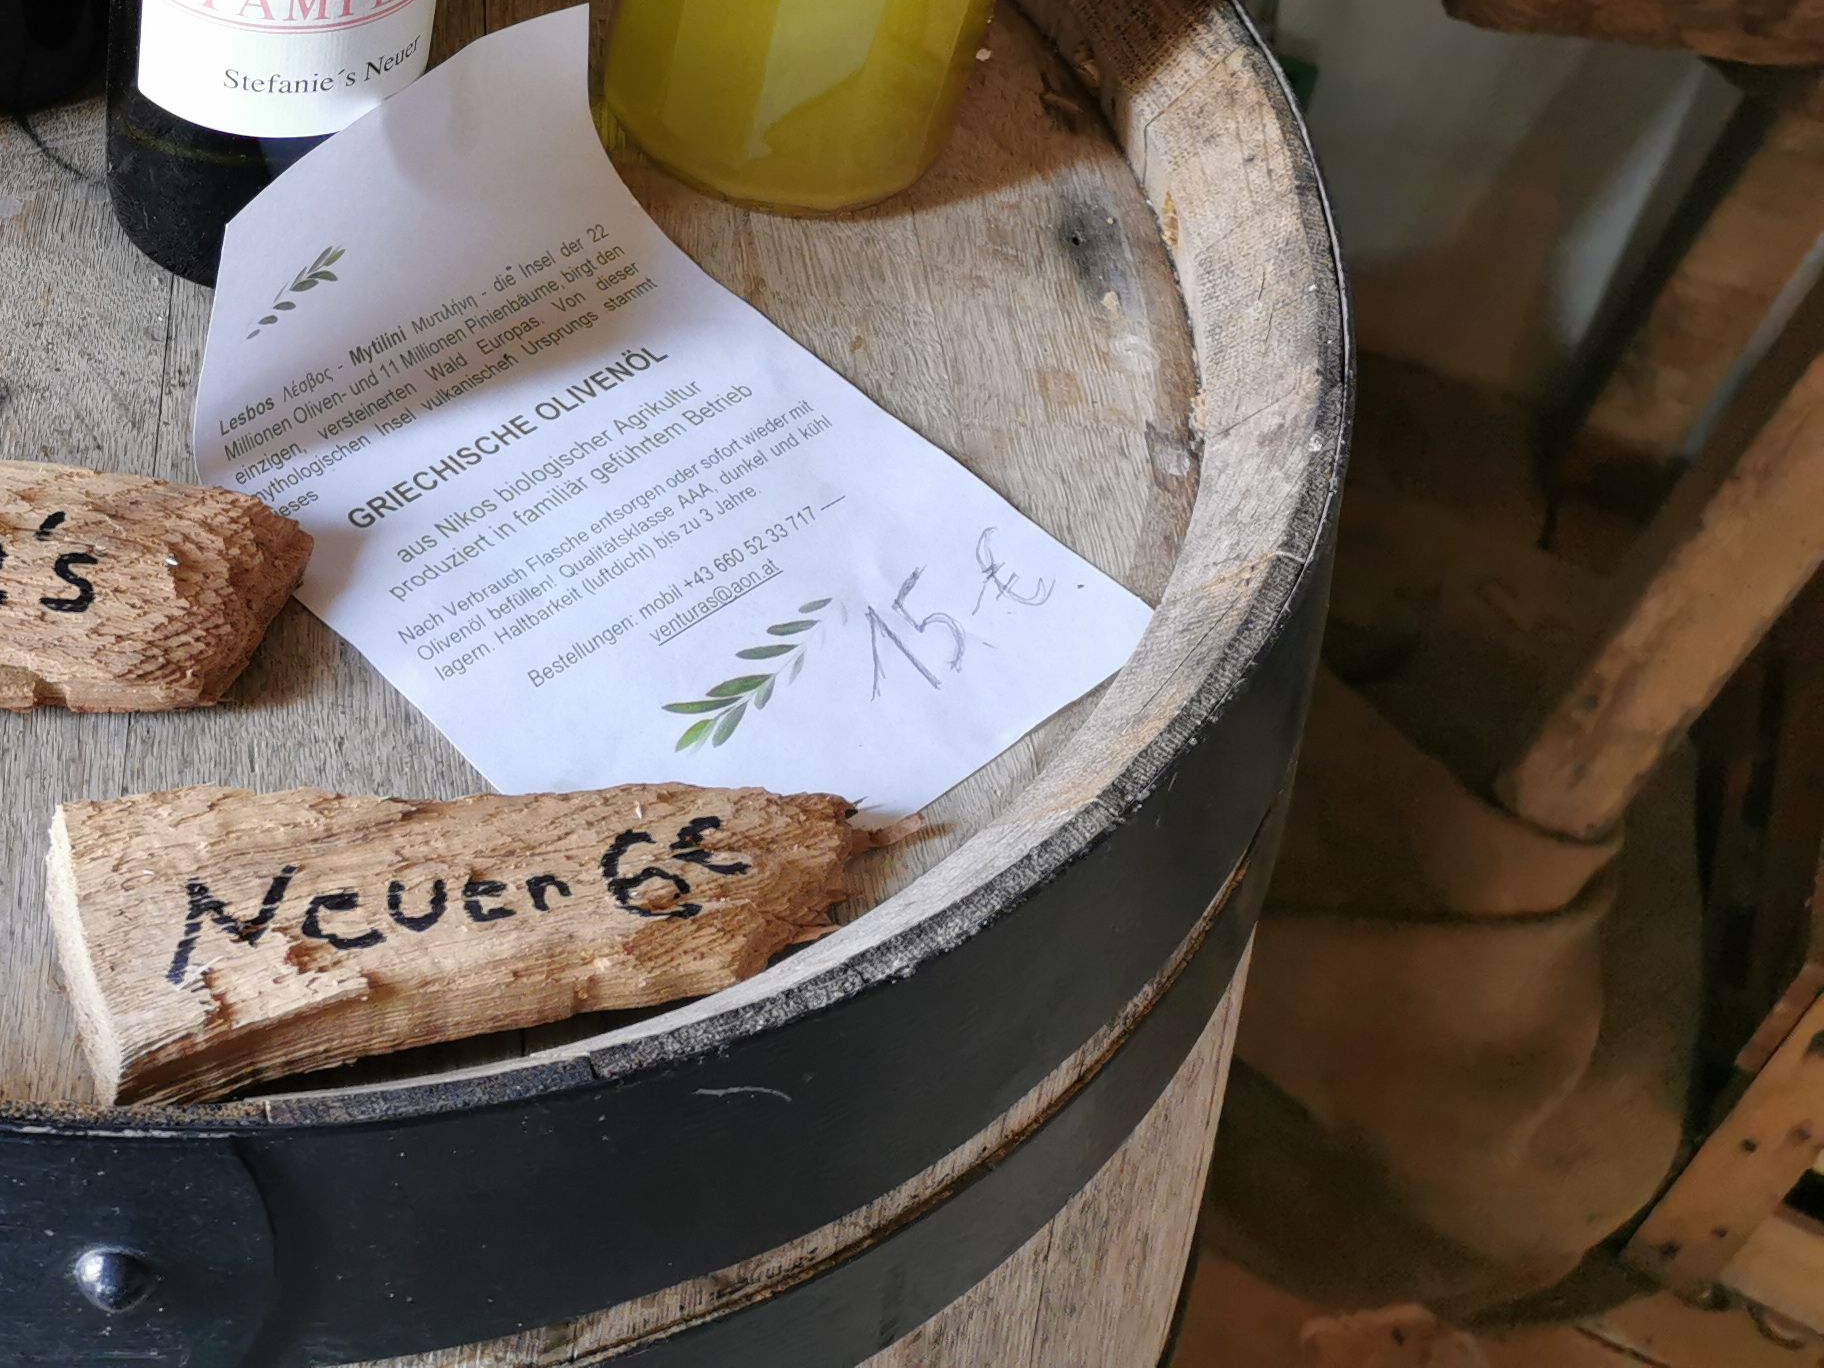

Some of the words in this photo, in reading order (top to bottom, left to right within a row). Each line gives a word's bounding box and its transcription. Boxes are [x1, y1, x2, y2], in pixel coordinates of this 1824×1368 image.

[363, 33, 422, 83] Neuer
[218, 396, 275, 437] Lesbos
[348, 325, 407, 367] Mytilini
[492, 271, 518, 294] die
[518, 250, 557, 280] Insel
[560, 237, 585, 259] der
[586, 223, 610, 244] 22
[224, 416, 292, 461] Millionen
[293, 391, 348, 425] Oliven-
[349, 371, 380, 397] und
[380, 358, 400, 380] 11
[400, 326, 467, 370] Millionen
[464, 275, 565, 334] Pinienbäume,
[561, 258, 598, 284] birgt
[596, 244, 626, 267] den
[234, 442, 308, 485] einzigen,
[318, 382, 417, 441] versteinerten
[424, 351, 469, 382] Wald
[476, 315, 545, 357] Europas.
[550, 290, 587, 314] Von
[595, 260, 640, 292] dieser
[374, 408, 417, 438] Insel
[420, 354, 520, 413] vulkanischen
[520, 309, 600, 357] Ursprungs
[603, 277, 659, 313] stammt
[347, 414, 539, 530] GRIECHISCHE
[534, 346, 670, 421] OLIVENÖL
[388, 534, 496, 603] produziert
[492, 522, 518, 541] in
[513, 475, 590, 527] familiär
[590, 422, 687, 484] geführtem
[681, 383, 753, 427] Betrieb
[397, 533, 439, 564] aus
[433, 497, 499, 539] Nikos
[493, 429, 614, 503] biologischer
[613, 380, 703, 436] Agrikultur
[397, 612, 446, 645] Nach
[442, 567, 529, 618] Verbrauch
[525, 530, 591, 574] Flasche
[590, 483, 668, 535] entsorgen
[665, 463, 701, 489] oder
[699, 439, 744, 471] sofort
[742, 414, 789, 446] wieder
[788, 399, 816, 423] mit
[416, 614, 487, 661] Olivenöl
[486, 574, 559, 621] befüllen!
[558, 504, 675, 579] Qualitätsklasse
[678, 481, 719, 510] AAA,
[719, 449, 770, 486] dunkel
[769, 432, 800, 458] und
[800, 414, 834, 440] kühl
[434, 641, 496, 681] lagern.
[494, 588, 584, 645] Haltbarkeit
[582, 543, 656, 596] (luftdicht)
[656, 529, 681, 551] bis
[679, 516, 702, 537] zu
[699, 507, 715, 524] 3
[717, 483, 762, 516] Jahre.
[527, 613, 639, 688] Bestellungen:
[639, 582, 684, 620] mobil
[683, 564, 716, 591] +43
[713, 547, 746, 574] 660
[743, 534, 769, 557] 52
[766, 523, 790, 545] 33
[785, 504, 817, 532] 717
[649, 557, 781, 643] venturas@aon.at
